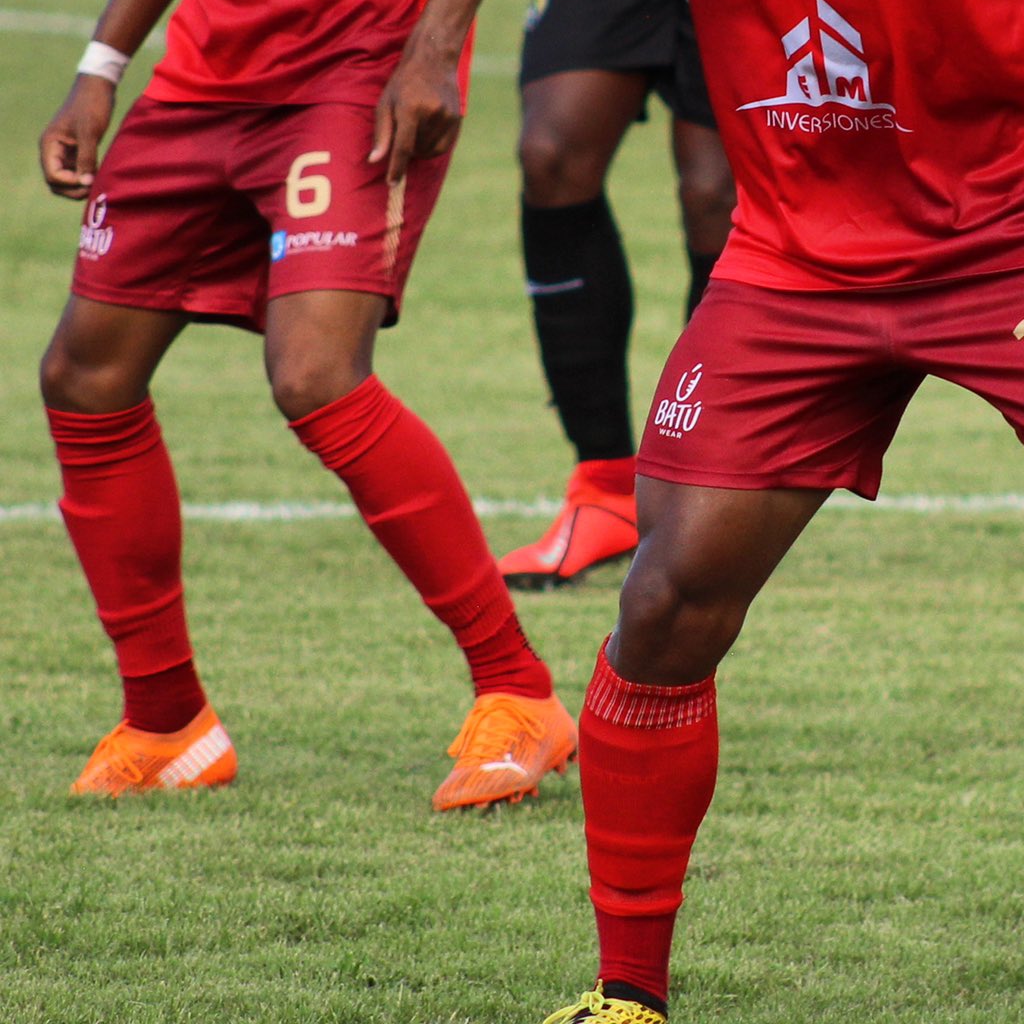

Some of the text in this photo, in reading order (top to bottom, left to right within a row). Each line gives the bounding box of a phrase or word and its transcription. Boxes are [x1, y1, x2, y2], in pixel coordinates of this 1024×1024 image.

[766, 109, 895, 133] INVERSIONES
[286, 151, 332, 219] 6
[287, 231, 358, 249] POPULAR
[654, 400, 702, 432] BATÚ
[659, 428, 682, 440] WEAR
